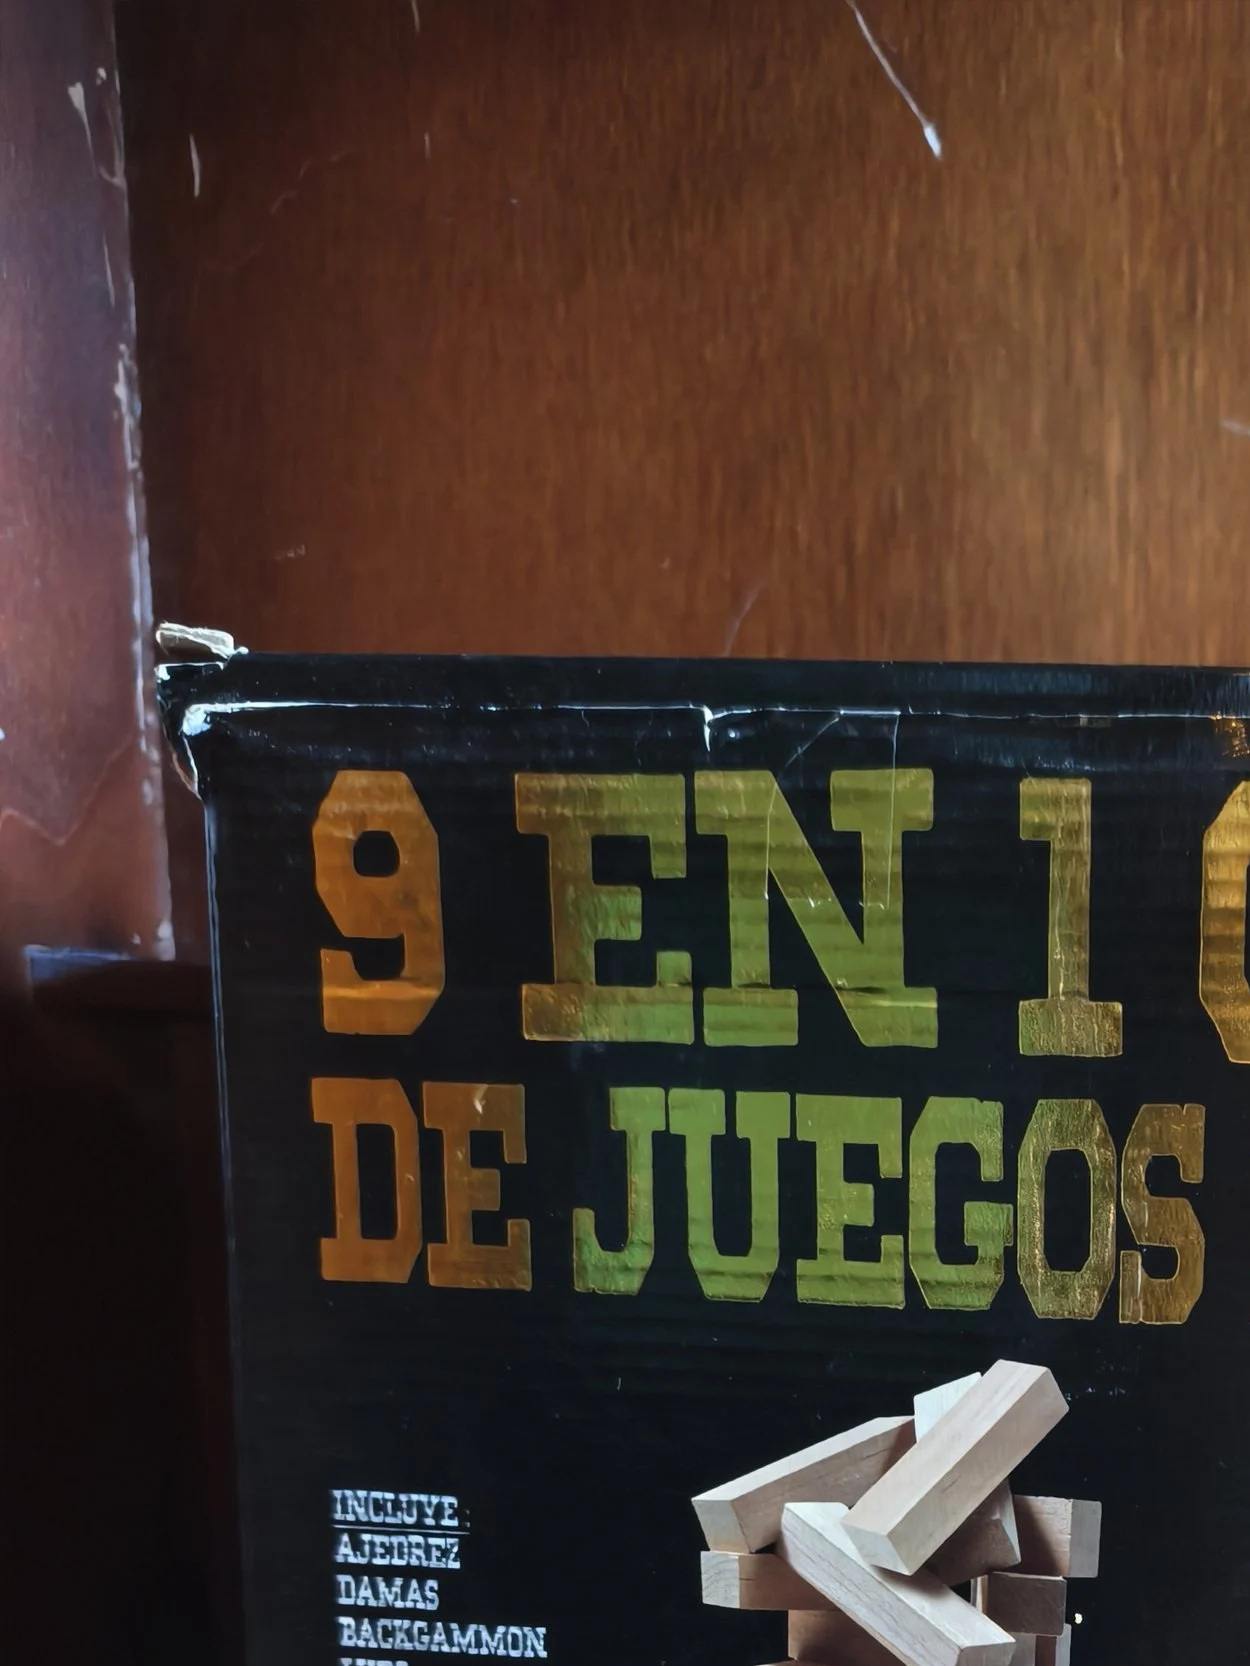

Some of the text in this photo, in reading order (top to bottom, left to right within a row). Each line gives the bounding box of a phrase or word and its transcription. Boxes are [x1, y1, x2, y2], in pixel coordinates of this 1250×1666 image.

[313, 769, 446, 1036] 9
[513, 767, 939, 1047] EN
[1018, 777, 1124, 1057] 1
[311, 1076, 532, 1291] DE
[572, 1085, 1206, 1325] JUEGOS
[334, 1532, 461, 1569] AJEDREZ
[335, 1574, 440, 1611] DAMAS
[337, 1616, 548, 1658] BACKGAMMON
